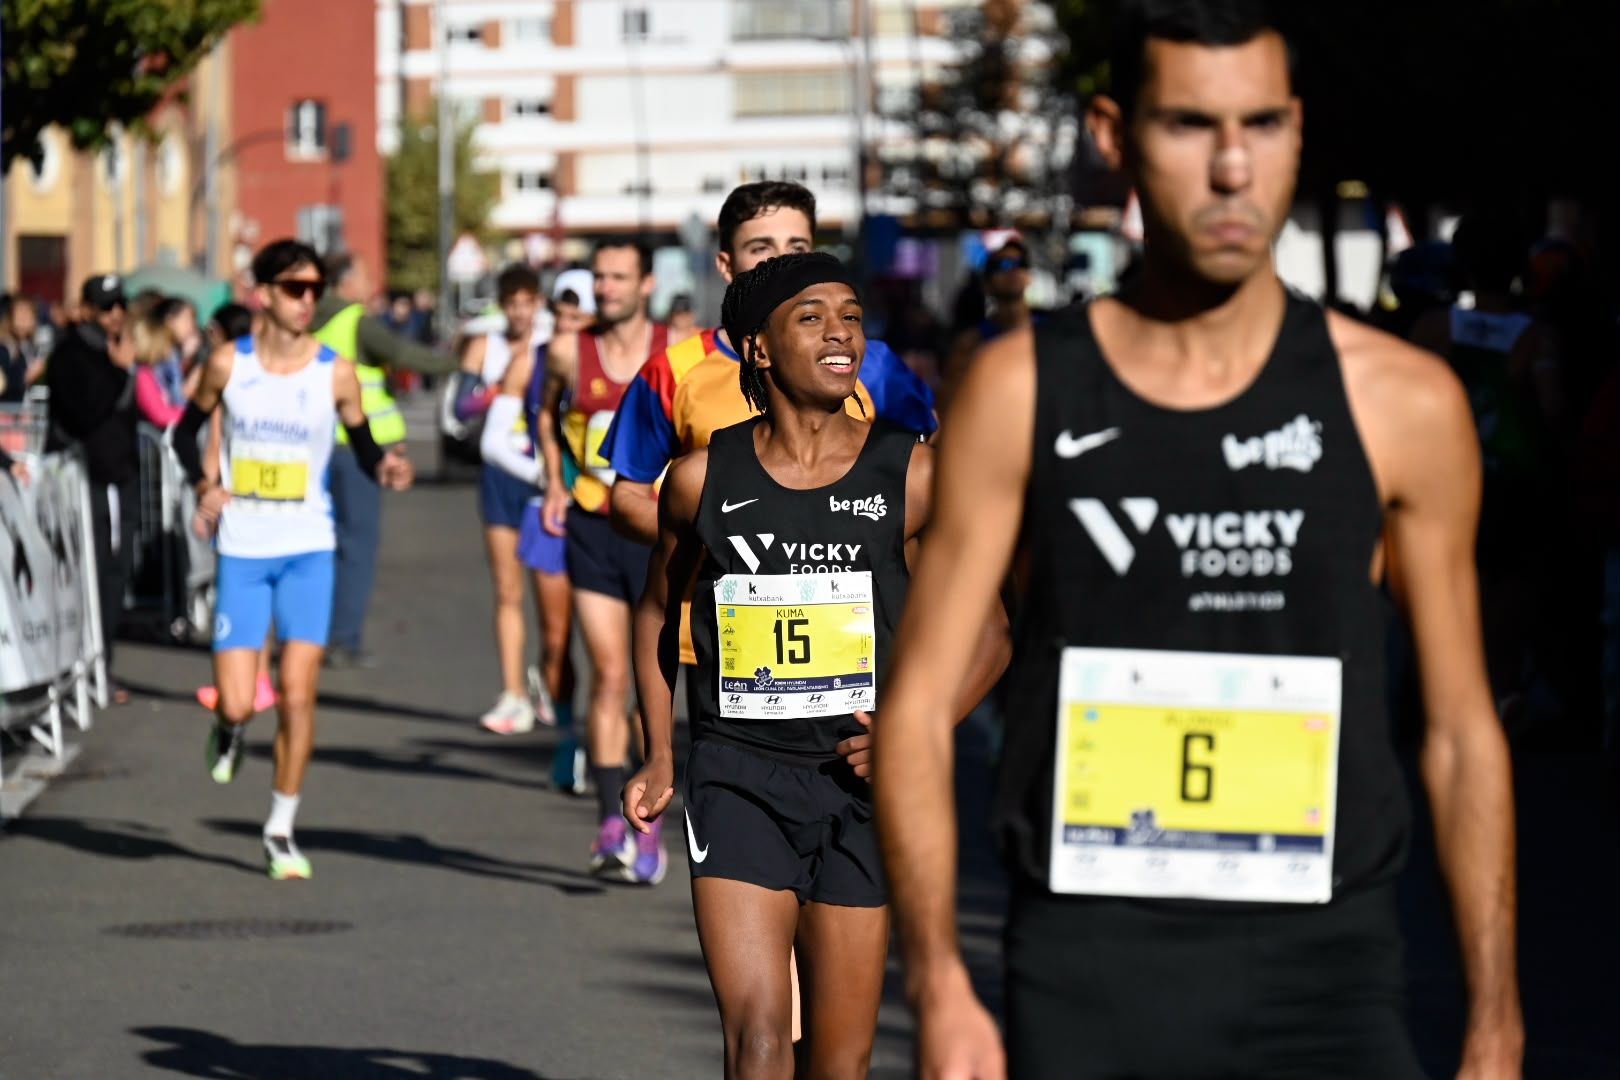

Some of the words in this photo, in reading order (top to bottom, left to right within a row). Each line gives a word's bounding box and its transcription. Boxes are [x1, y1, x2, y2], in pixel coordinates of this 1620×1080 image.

[259, 465, 279, 490] 13
[829, 495, 850, 513] be
[852, 493, 888, 521] plus
[1165, 509, 1305, 549] VICKY
[782, 542, 862, 562] VICKY
[1181, 547, 1293, 577] FOODS
[790, 563, 853, 575] FOODS
[776, 608, 805, 619] KUMA
[773, 618, 811, 665] 15
[1180, 731, 1215, 803] 6
